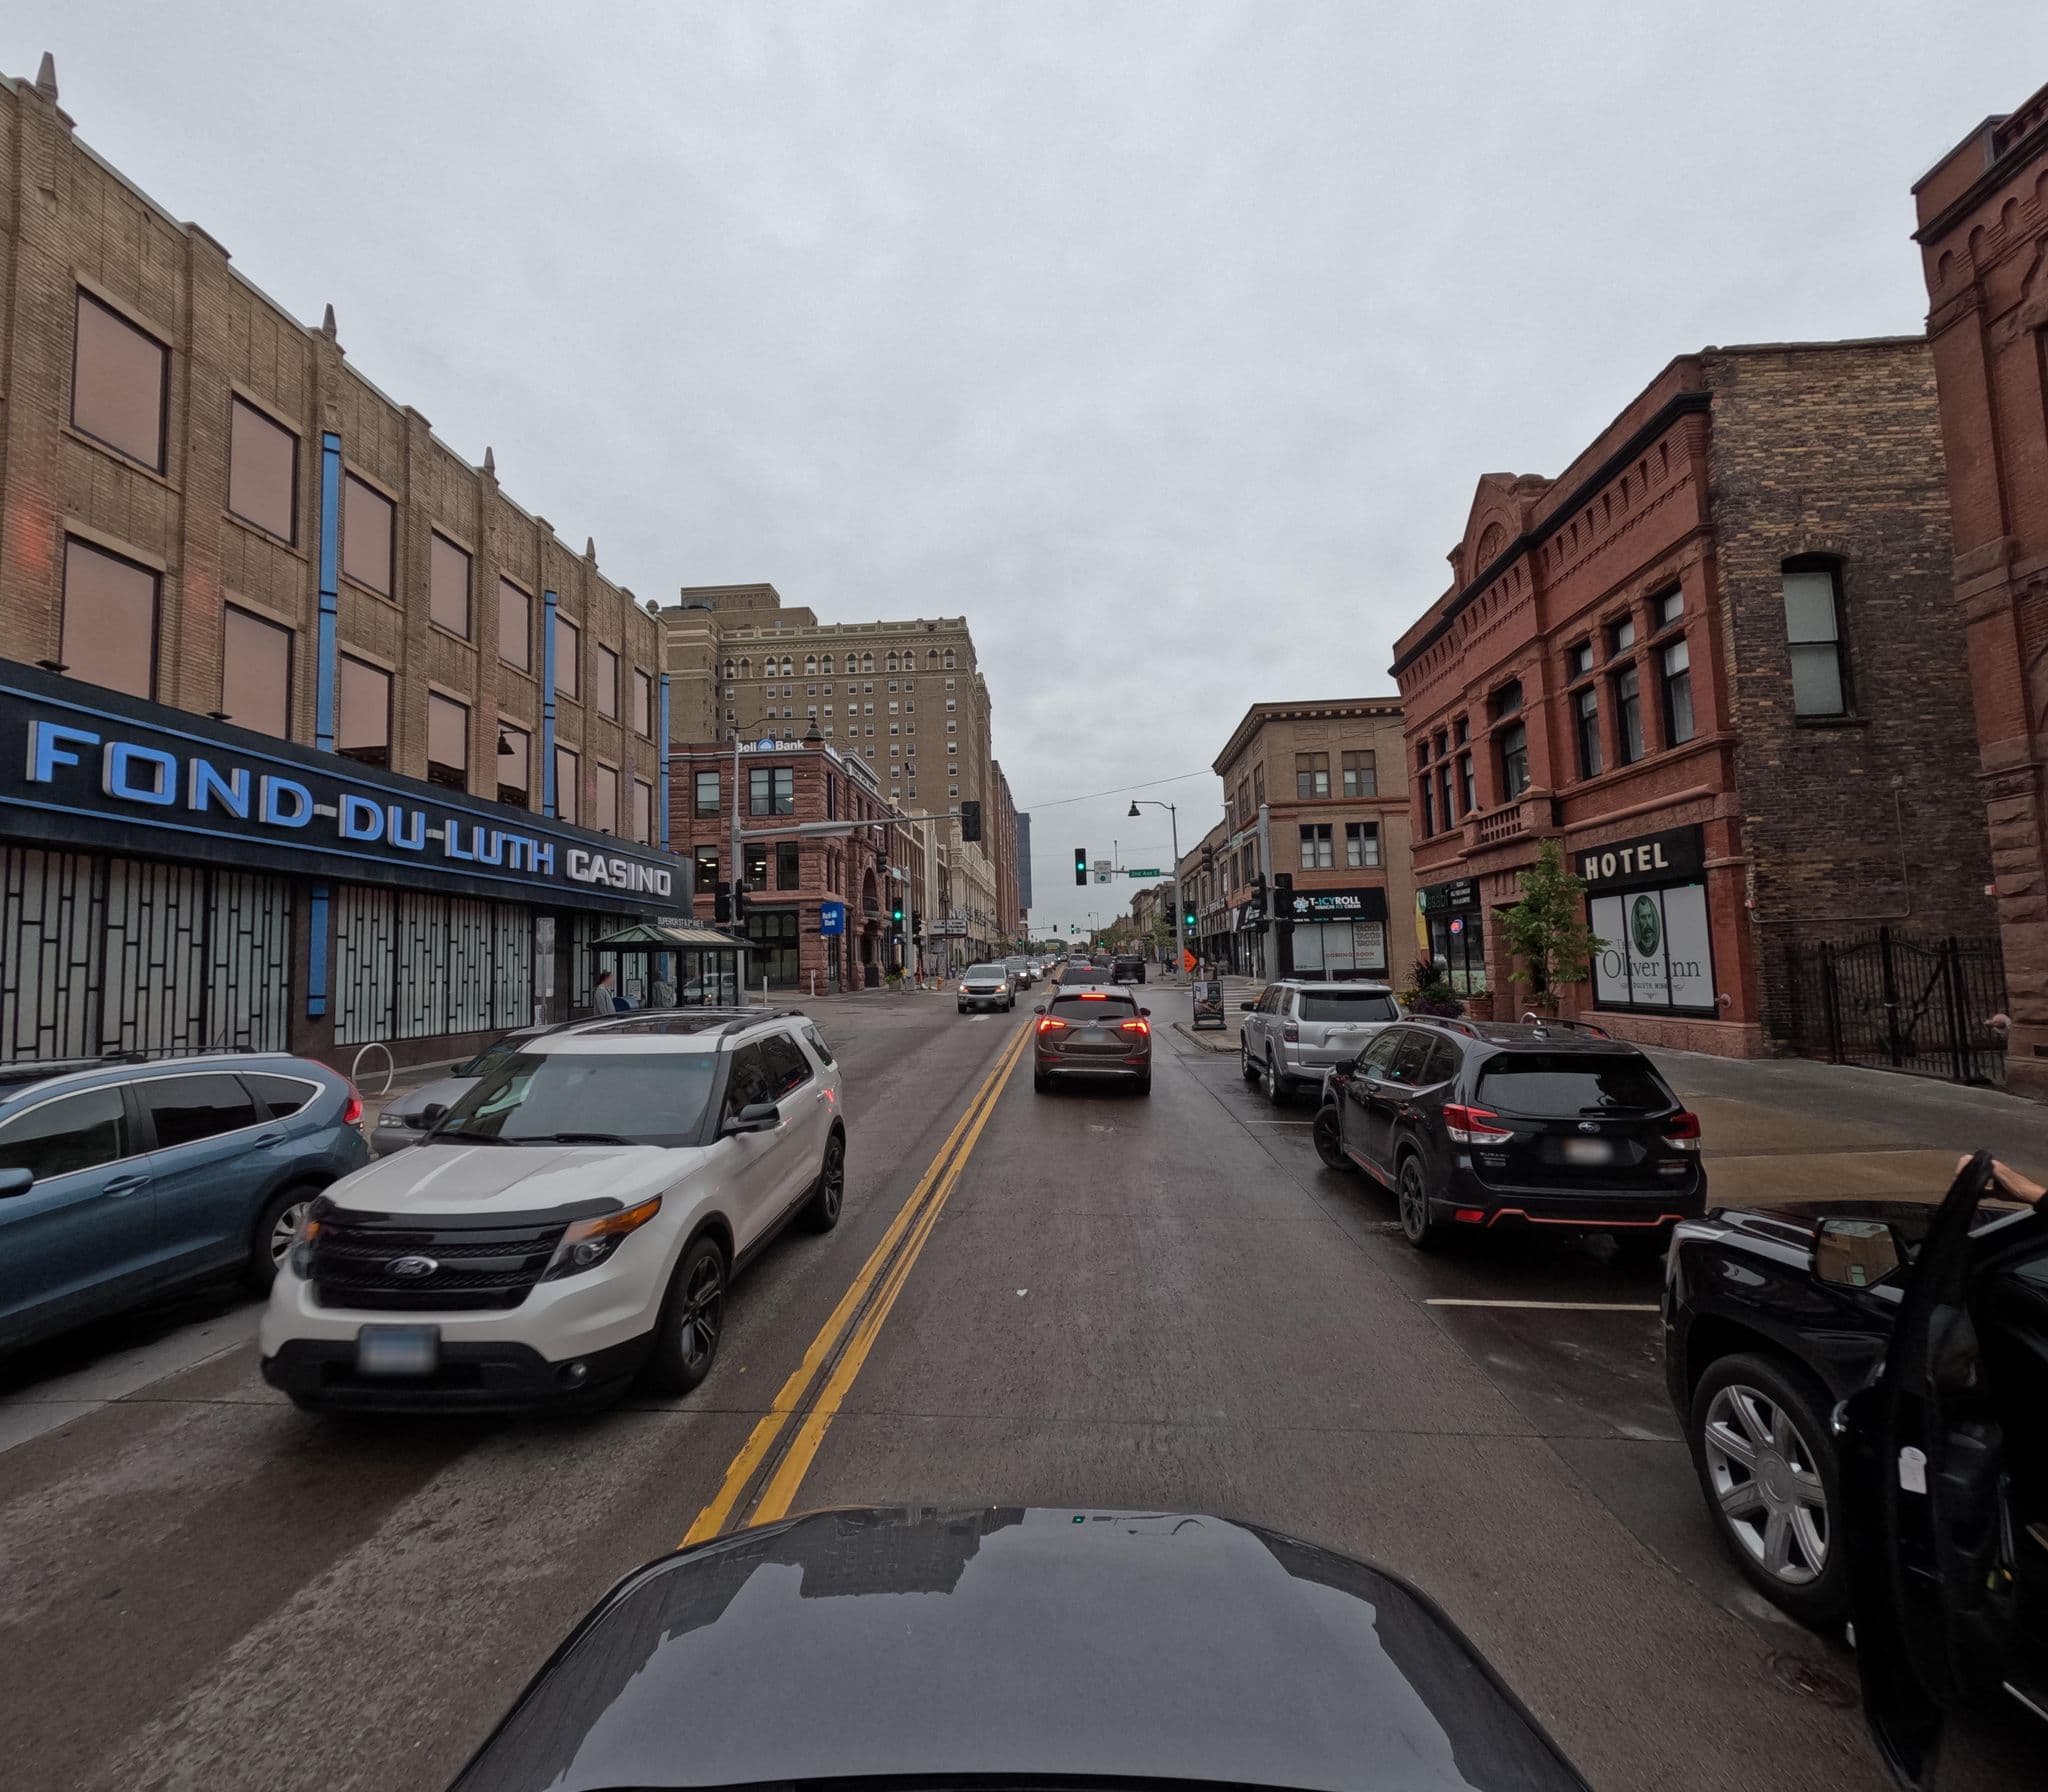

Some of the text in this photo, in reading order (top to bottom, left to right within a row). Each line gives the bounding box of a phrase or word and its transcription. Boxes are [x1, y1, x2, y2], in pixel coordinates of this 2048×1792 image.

[738, 740, 804, 752] Bell Bank
[26, 719, 672, 897] FOND-DU-LUTH CASINO
[1585, 842, 1669, 880] HOTEL
[1309, 896, 1360, 905] T-ICYROLL
[658, 917, 678, 925] SUPERIOR
